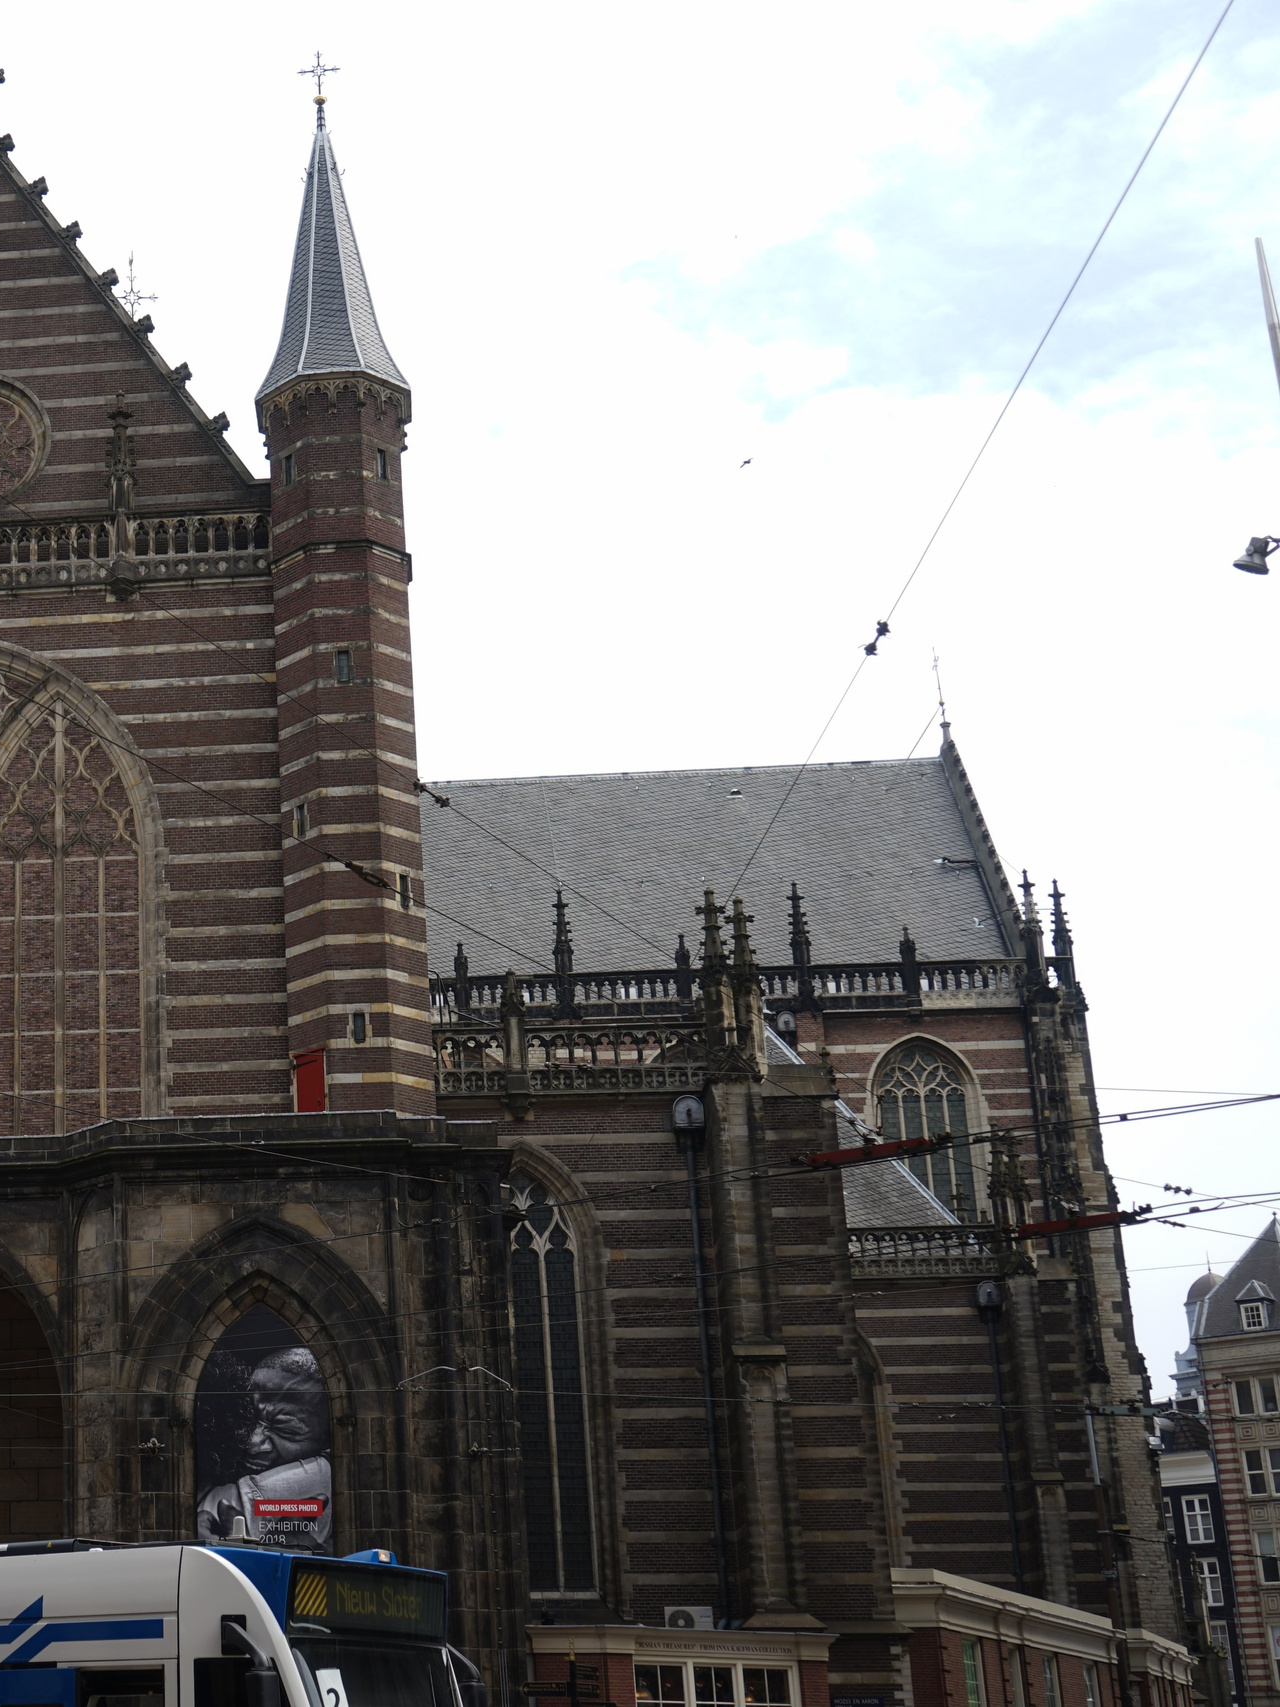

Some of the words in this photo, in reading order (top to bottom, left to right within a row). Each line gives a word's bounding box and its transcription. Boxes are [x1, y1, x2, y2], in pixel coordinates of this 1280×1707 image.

[259, 1504, 280, 1512] WORLD
[280, 1504, 298, 1512] PRESS
[298, 1504, 318, 1512] PHOTO
[258, 1521, 318, 1532] EXHIBITION
[259, 1534, 287, 1544] 2018
[335, 1580, 378, 1616] Nieuw
